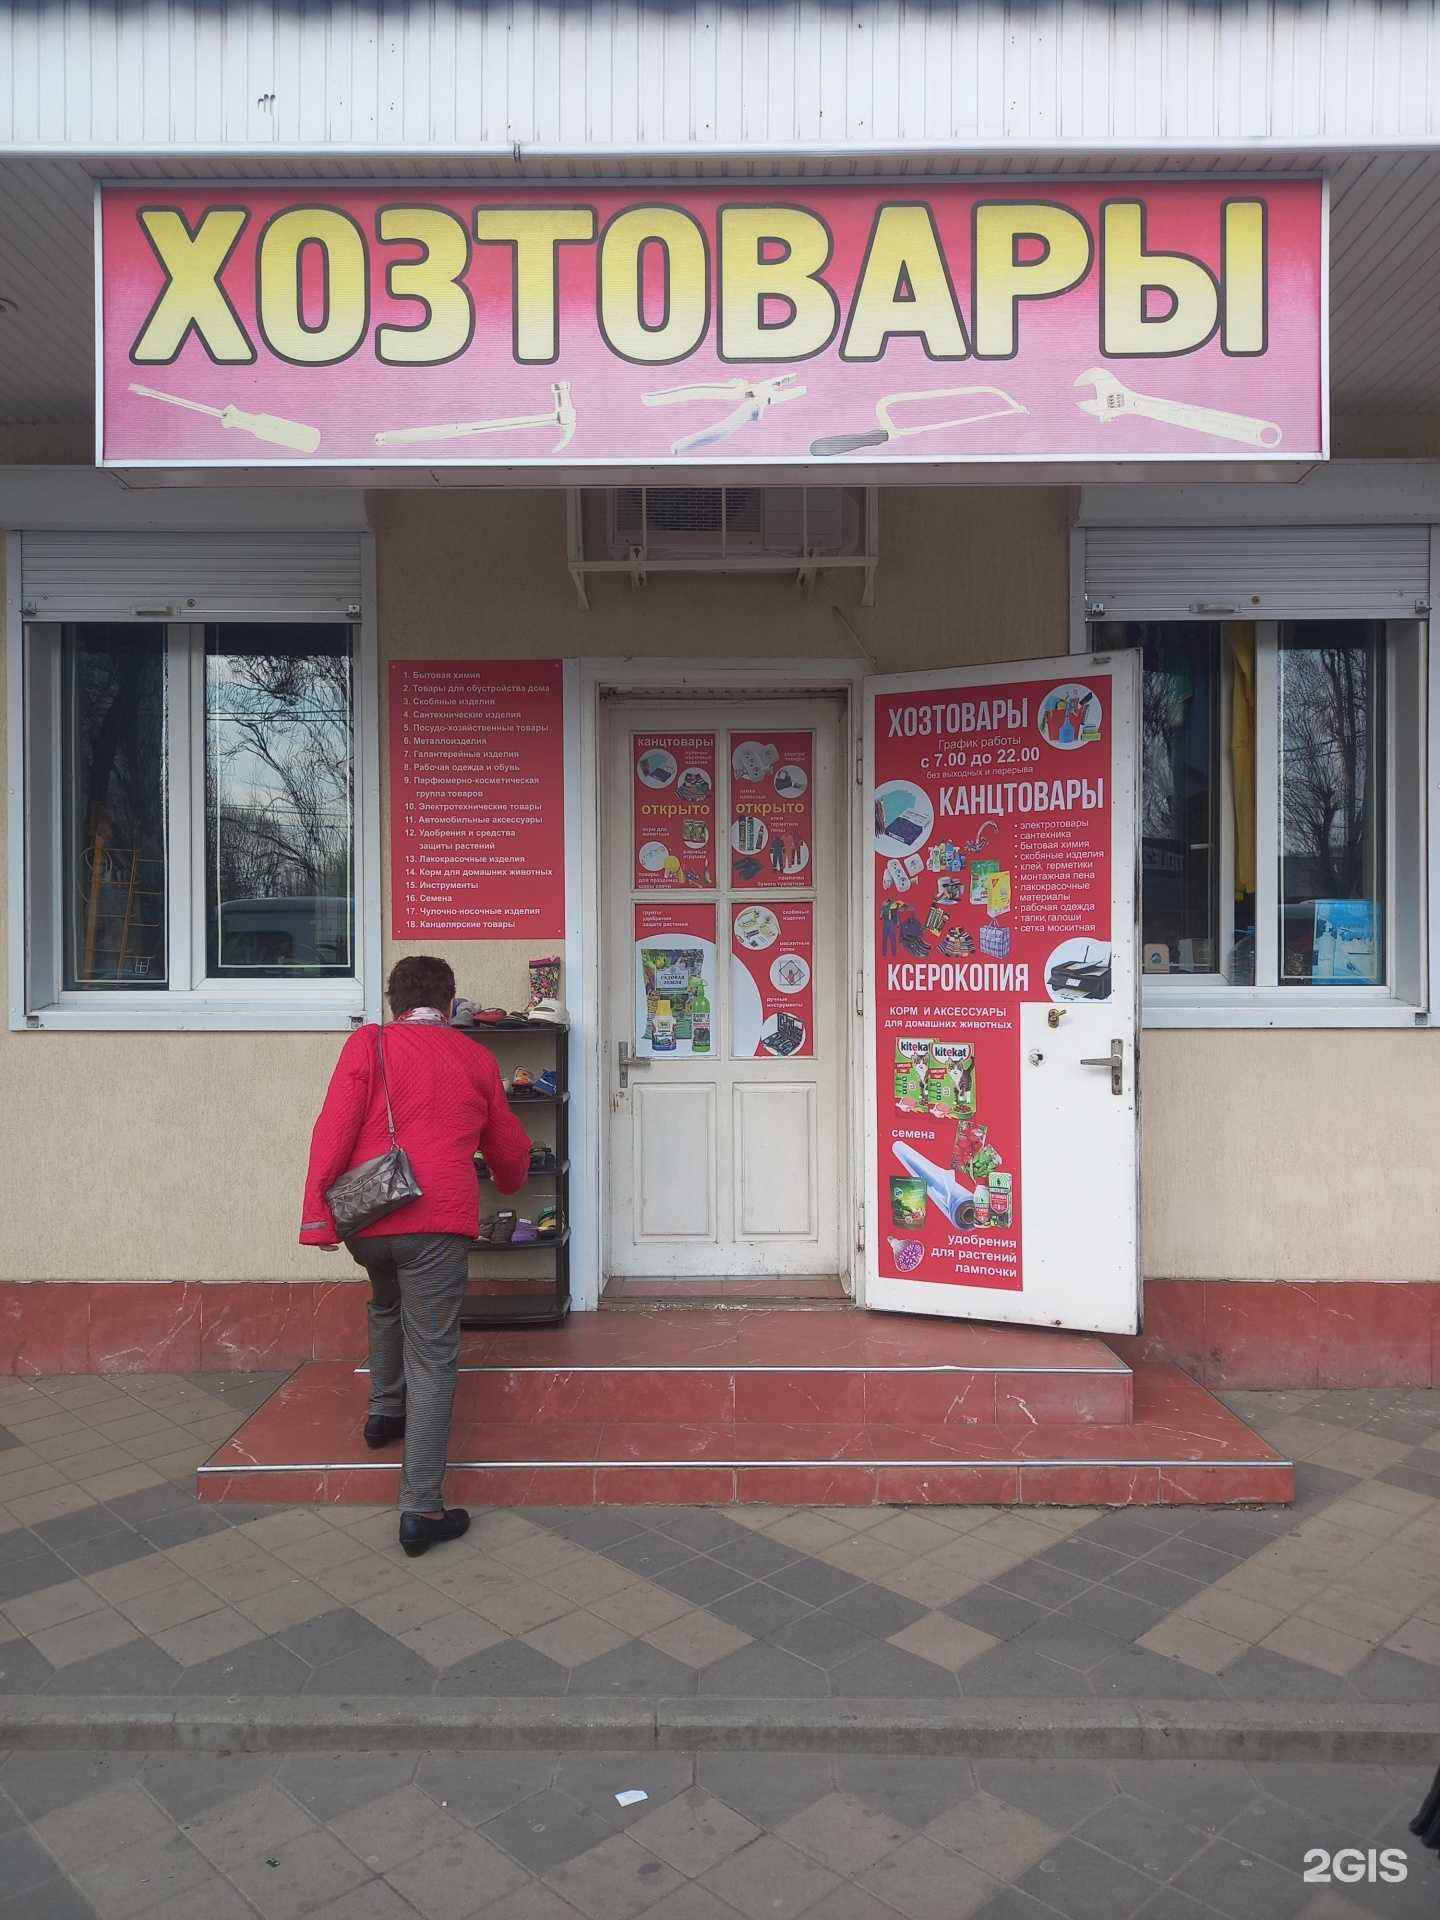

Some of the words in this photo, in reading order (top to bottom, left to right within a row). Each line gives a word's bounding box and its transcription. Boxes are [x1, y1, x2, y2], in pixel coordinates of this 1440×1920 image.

[129, 197, 1268, 366] ХОЗТОВАРЫ
[453, 672, 481, 680] химия
[414, 685, 445, 694] Товары
[467, 685, 526, 694] обустройства
[529, 685, 550, 693] дома
[458, 698, 495, 706] изделия
[484, 711, 521, 719] изделия
[888, 699, 1027, 737] ХОЗТОВАРЫ
[413, 724, 514, 732] Посудо-хозяйственные
[516, 725, 549, 733] товары
[414, 737, 487, 746] Металлоизделия
[638, 738, 713, 748] канцтовары
[939, 739, 978, 752] График
[981, 736, 1021, 747] работы
[414, 750, 480, 759] Галантерейные
[483, 751, 519, 759] изделия
[921, 759, 929, 768] с
[934, 753, 965, 767] 7.00
[971, 754, 991, 766] до
[997, 747, 1039, 763] 22.00
[414, 763, 450, 771] Рабочая
[452, 764, 484, 772] одежда
[494, 764, 520, 772] обувь
[927, 771, 940, 779] без
[942, 769, 982, 777] выходных
[993, 767, 1033, 775] перерыва
[414, 777, 539, 785] Парфюмерно-косметическая
[416, 791, 445, 799] группа
[447, 790, 483, 799] товаров
[939, 779, 1104, 817] КАНЦТОВАРЫ
[418, 803, 507, 811] Электротехнические
[509, 804, 542, 812] товары
[641, 804, 710, 817] открыто
[736, 803, 804, 816] открыто
[418, 816, 490, 824] Автомобильные
[492, 816, 543, 825] аксессуары
[1020, 820, 1088, 829] электротовары
[419, 829, 466, 838] Удобрения
[476, 830, 515, 838] средства
[1020, 831, 1071, 839] сантехника
[419, 843, 453, 851] защиты
[455, 842, 495, 851] растений
[419, 855, 487, 864] Лакокрасочные
[489, 856, 525, 864] изделия
[1020, 852, 1063, 860] скобяные
[1067, 851, 1104, 859] изделия
[1047, 862, 1093, 870] герметики
[419, 868, 441, 877] Корм
[463, 869, 507, 877] домашних
[406, 881, 417, 889] 15.
[420, 882, 479, 890] Инструменты
[1020, 883, 1090, 892] лакокрасочные
[1020, 894, 1070, 902] материалы
[406, 907, 417, 915] 17.
[420, 908, 502, 916] Чулочно-носочные
[504, 908, 540, 916] изделия
[1020, 904, 1058, 913] рабочая
[406, 920, 418, 928] 18.
[420, 921, 481, 929] Канцелярские
[483, 921, 515, 930] товары
[888, 964, 1029, 992] КСЕРОКОПИЯ
[890, 1006, 918, 1016] КОРМ
[924, 1007, 931, 1016] И
[933, 1007, 1006, 1017] АКСЕССУАРЫ
[884, 1019, 903, 1028] для
[905, 1019, 957, 1029] домашних
[960, 1021, 1012, 1029] животных
[935, 1047, 968, 1058] kitekat
[891, 1128, 935, 1139] семена
[948, 1234, 1017, 1249] удобрения
[931, 1247, 954, 1258] для
[958, 1249, 1017, 1264] растений
[955, 1262, 1017, 1278] лампочки
